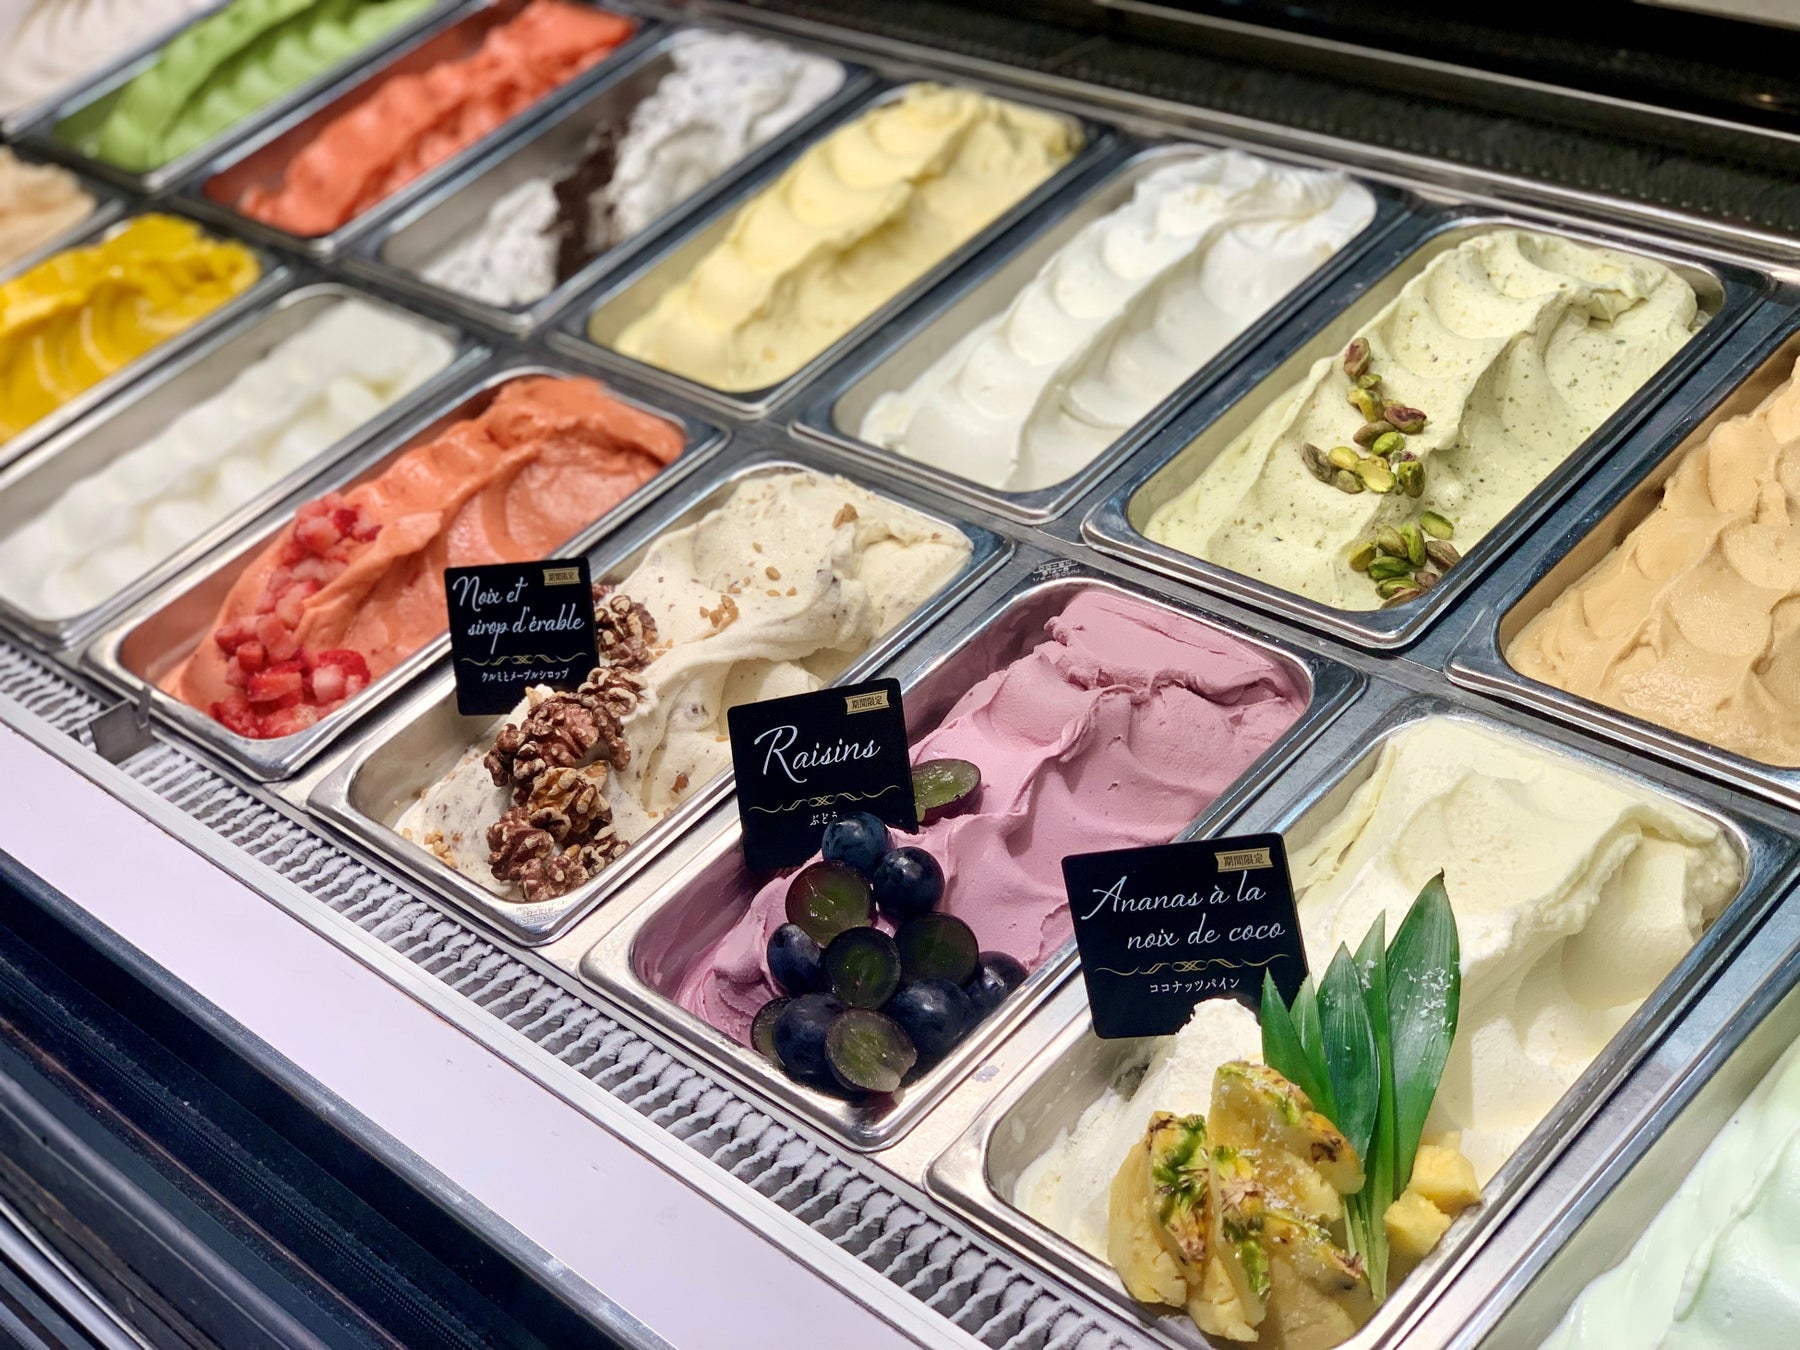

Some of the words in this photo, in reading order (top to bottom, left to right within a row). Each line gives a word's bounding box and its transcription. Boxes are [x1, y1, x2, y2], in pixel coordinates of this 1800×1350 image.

[452, 575, 503, 612] Noix
[506, 576, 529, 603] et
[467, 619, 509, 655] sirop
[511, 602, 585, 633] d'érable
[481, 667, 570, 682] クルミとメープルシロップ
[753, 724, 881, 784] Raisins
[1223, 852, 1265, 867] 期間限定
[1080, 875, 1204, 921] Ananas
[1209, 884, 1231, 905] à
[1234, 869, 1267, 902] la
[1127, 928, 1180, 950] noix
[1187, 912, 1221, 945] de
[1228, 922, 1286, 942] coco
[1149, 977, 1240, 994] ココナッツパイン
